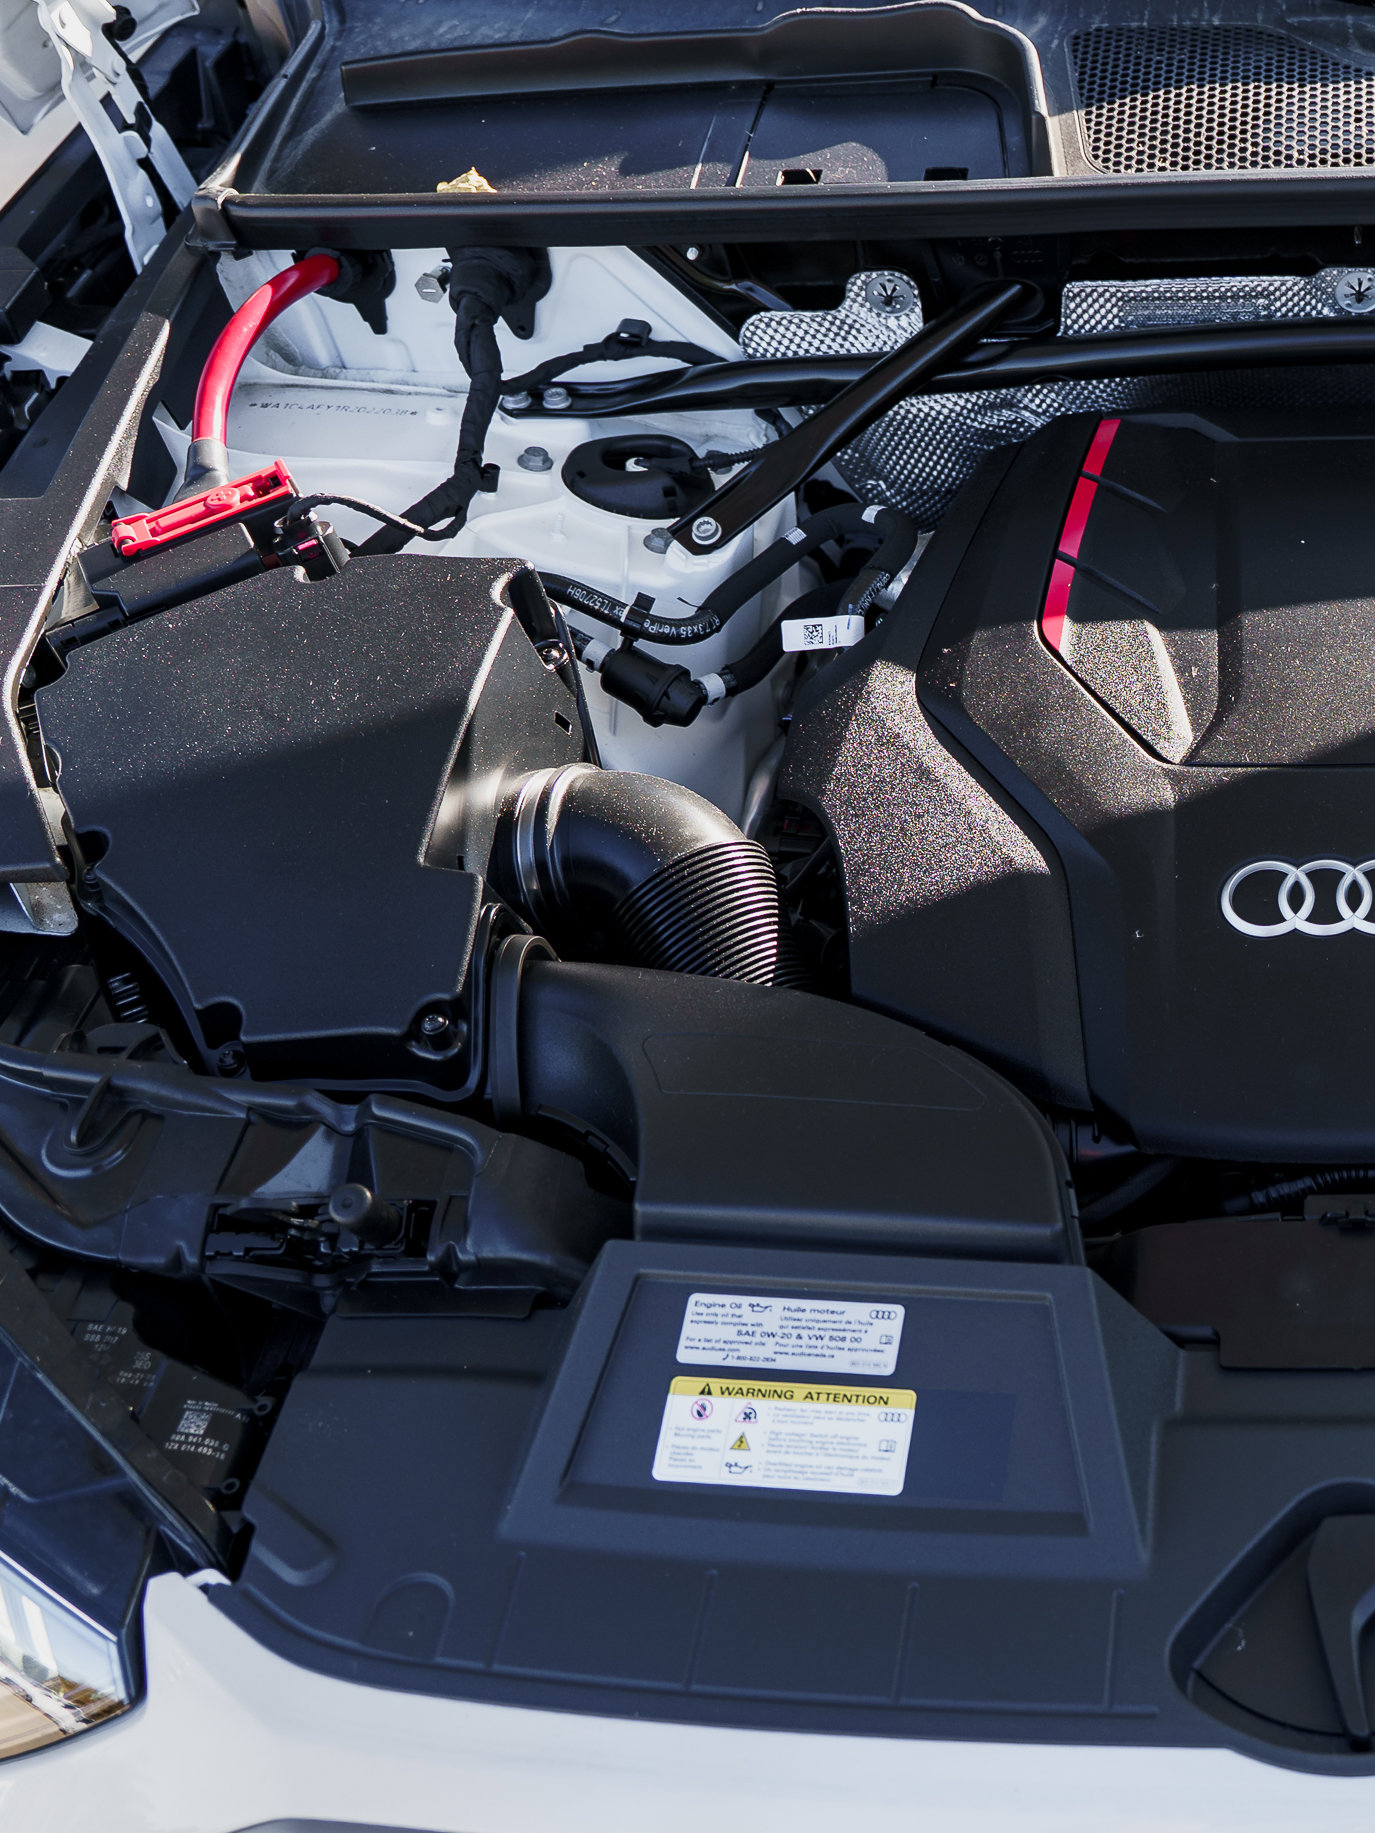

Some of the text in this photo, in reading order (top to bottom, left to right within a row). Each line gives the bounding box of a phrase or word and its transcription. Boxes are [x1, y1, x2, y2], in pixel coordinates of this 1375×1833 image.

[694, 1300, 726, 1309] Engine
[782, 1305, 846, 1316] Huile moteur
[736, 1329, 756, 1337] SAE
[760, 1331, 793, 1339] 0W-20
[807, 1333, 826, 1341] VW
[719, 1386, 889, 1406] WARNING ATTENTION
